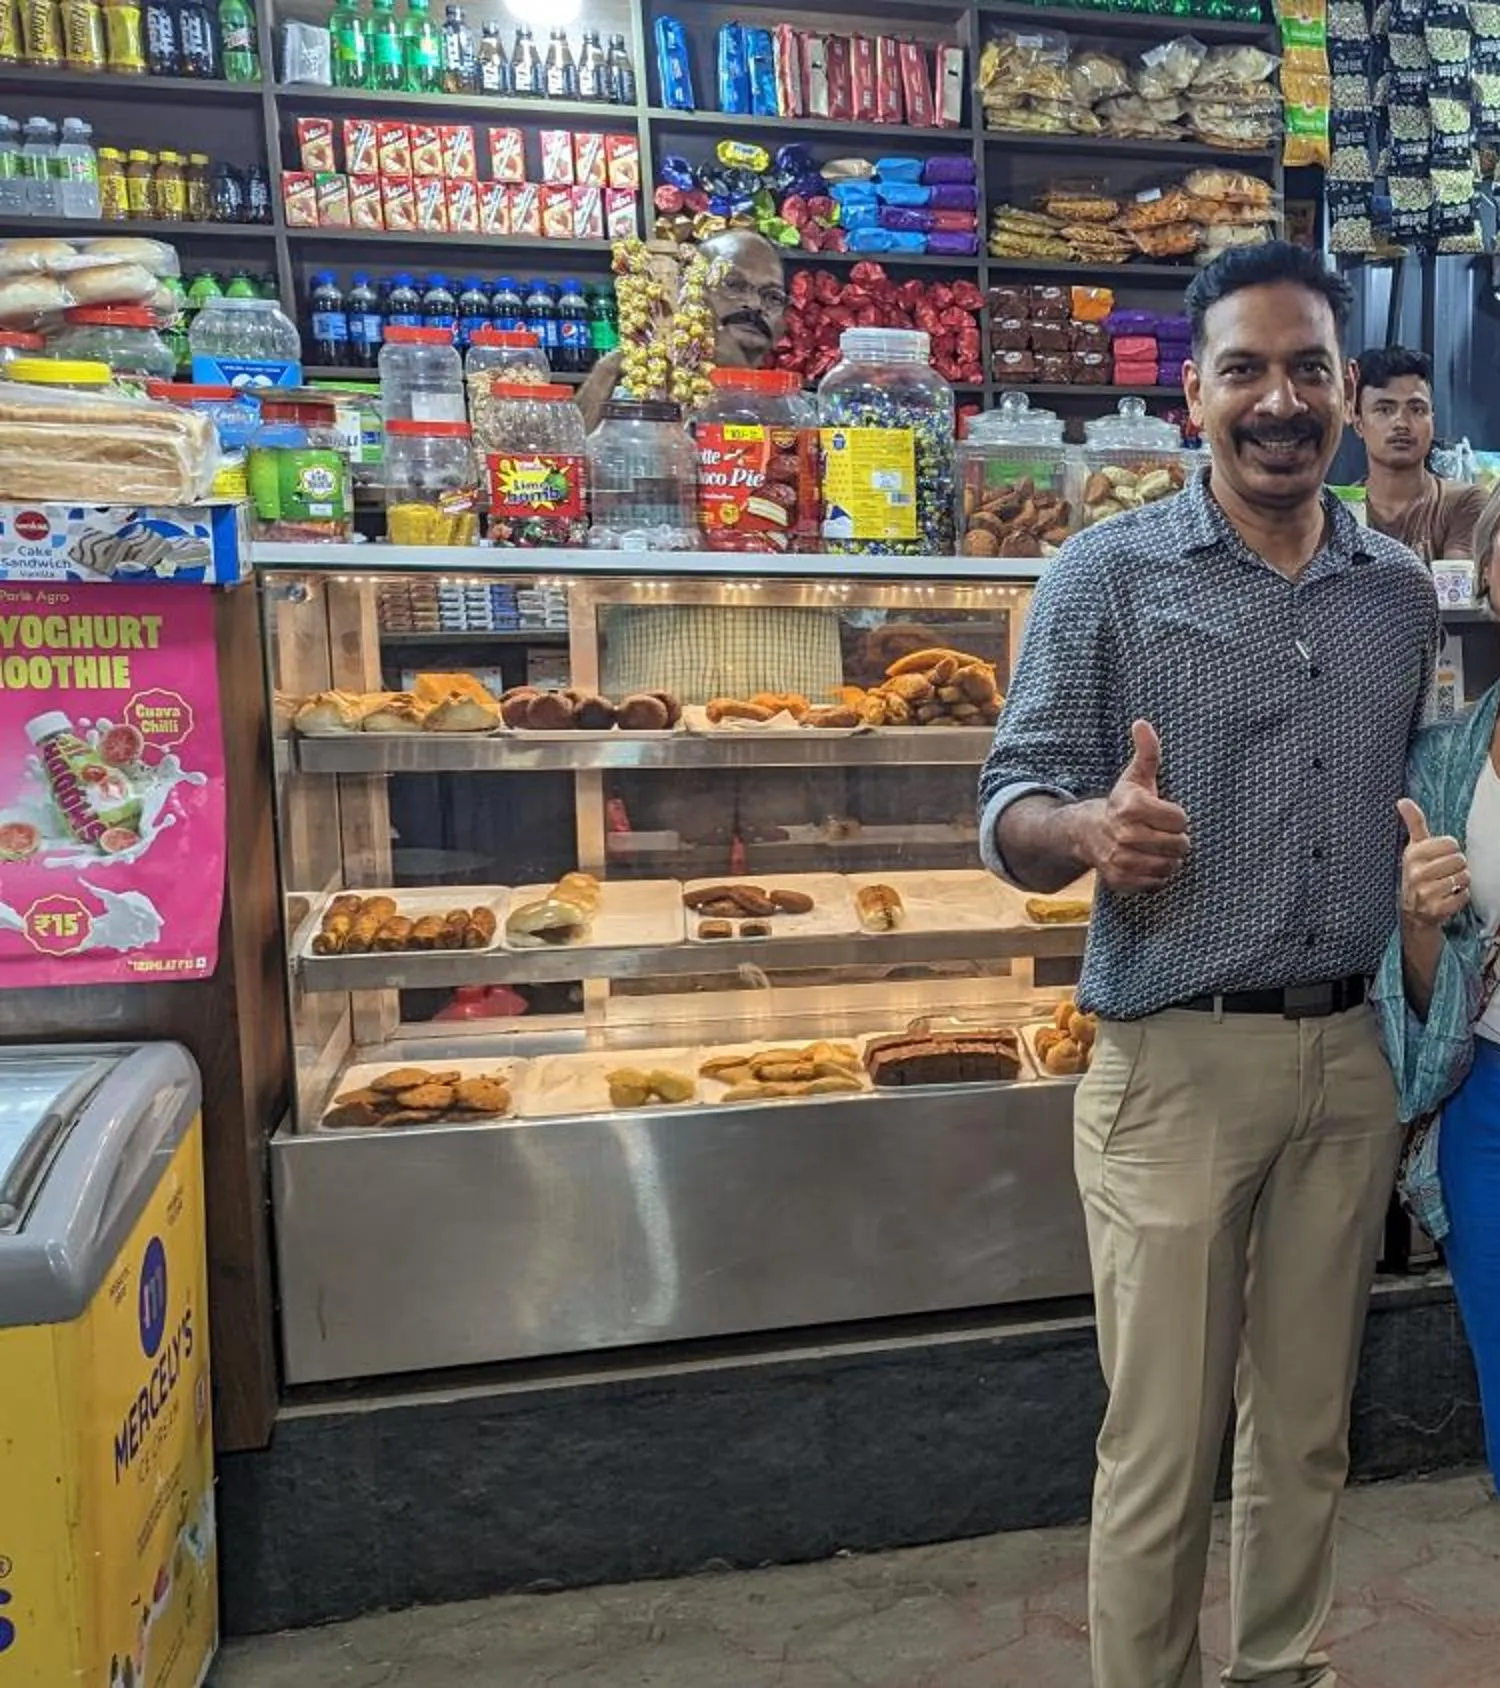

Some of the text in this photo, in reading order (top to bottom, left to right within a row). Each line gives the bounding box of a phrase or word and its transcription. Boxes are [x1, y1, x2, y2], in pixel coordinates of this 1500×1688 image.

[18, 545, 53, 557] Cake
[1, 558, 71, 569] Sandwich
[36, 590, 70, 605] Agro
[0, 615, 162, 649] YOGHURT
[0, 655, 131, 689] OOTHIE
[135, 703, 181, 718] Guava
[141, 719, 179, 733] Chilli
